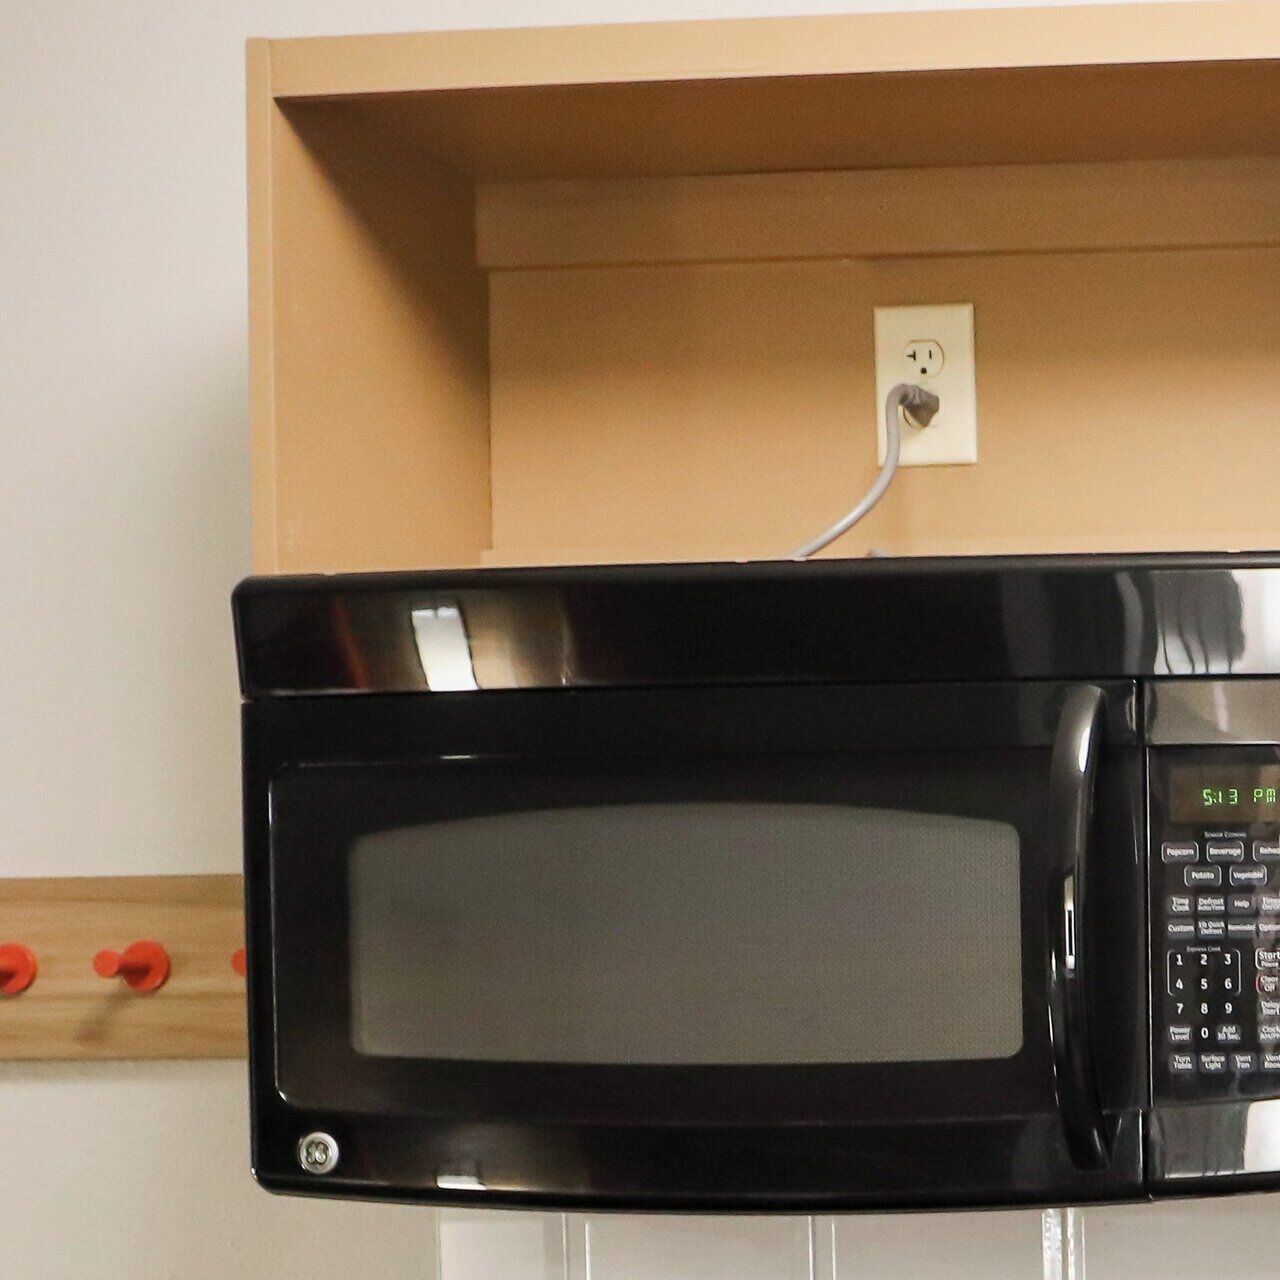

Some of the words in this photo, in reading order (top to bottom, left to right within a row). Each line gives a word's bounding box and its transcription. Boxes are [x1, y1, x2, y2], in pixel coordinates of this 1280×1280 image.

[1166, 848, 1194, 856] Popcorn
[1209, 847, 1241, 856] Beverage
[1192, 871, 1214, 879] Potato
[1199, 897, 1224, 906] Defrost
[1234, 900, 1250, 909] Help
[1168, 924, 1195, 932] Custom
[1176, 954, 1183, 966] 1
[1200, 954, 1208, 966] 2
[1224, 953, 1231, 965] 3
[1259, 951, 1280, 960] Start
[1175, 978, 1184, 990] 4
[1200, 978, 1208, 990] 5
[1224, 978, 1232, 989] 6
[1176, 1003, 1184, 1014] 7
[1201, 1002, 1209, 1014] 8
[1225, 1002, 1233, 1014] 9
[1201, 1027, 1209, 1039] 0
